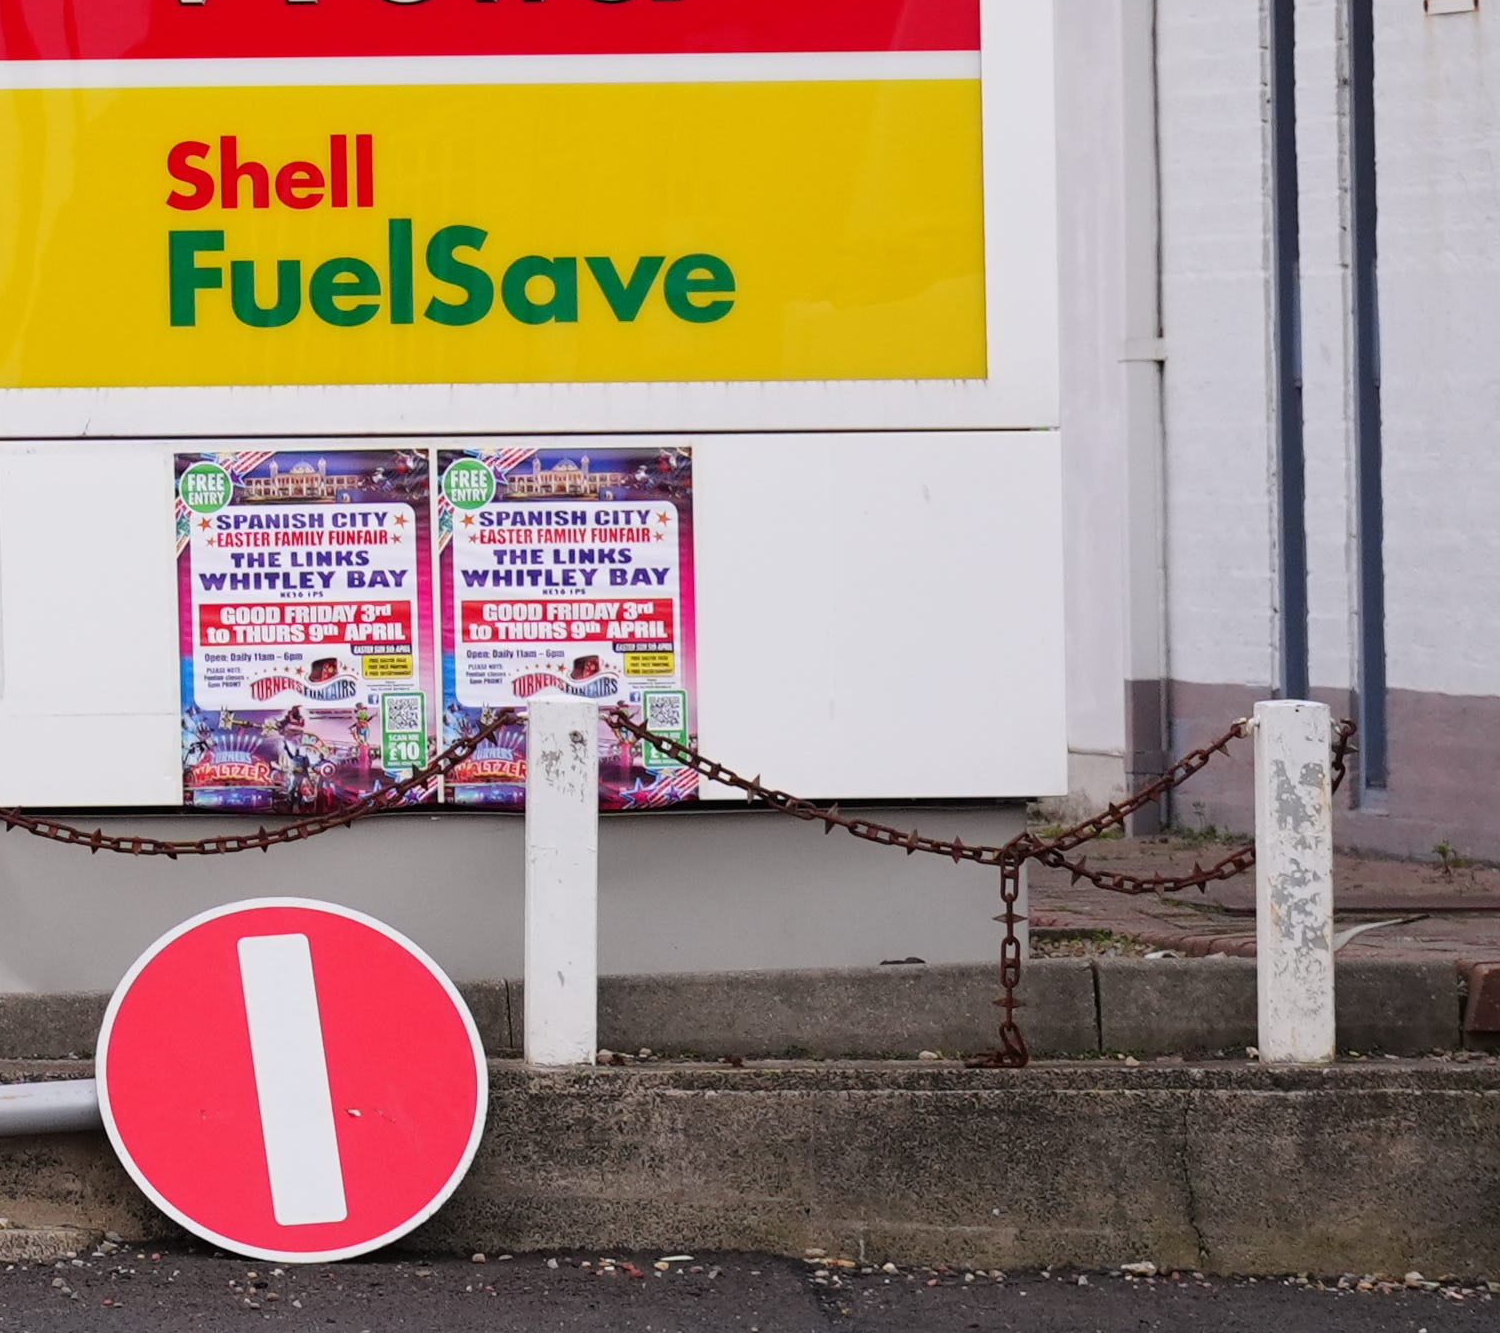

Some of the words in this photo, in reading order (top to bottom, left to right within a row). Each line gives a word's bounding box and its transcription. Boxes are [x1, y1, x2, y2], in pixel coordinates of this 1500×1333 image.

[165, 133, 375, 213] Shell
[167, 218, 736, 327] FuelSave
[188, 473, 224, 492] FREE
[450, 470, 488, 488] FREE
[188, 491, 225, 505] ENTRY
[451, 488, 488, 503] ENTRY
[216, 513, 325, 530] SPANISH
[332, 511, 388, 528] CITY
[479, 510, 587, 527] SPANISH
[594, 509, 651, 525] CITY
[217, 532, 270, 548] EASTER
[275, 531, 324, 547] FAMILY
[329, 530, 388, 545] FUNFAIR
[479, 529, 532, 545] EASTER
[537, 528, 586, 544] FAMILY
[591, 527, 650, 543] FUNFAIR
[231, 552, 281, 568] THE
[291, 550, 369, 567] LINKS
[493, 549, 544, 565] THE
[553, 548, 632, 564] LINKS
[199, 571, 336, 591] WHITLEY
[347, 570, 408, 589] BAY
[461, 569, 598, 587] WHITLEY
[609, 568, 671, 587] BAY
[220, 606, 281, 625] GOOD
[284, 605, 357, 624] FRIDAY
[361, 603, 392, 622] 3rd
[482, 603, 543, 622] GOOD
[546, 602, 620, 621] FRIDAY
[623, 602, 654, 620] 3rd
[207, 627, 230, 644] to
[233, 624, 305, 643] THURS
[309, 624, 338, 642] 9th
[344, 623, 406, 641] APRIL
[469, 623, 492, 641] to
[495, 622, 567, 640] THURS
[571, 621, 600, 639] 9th
[606, 621, 667, 638] APRIL
[230, 653, 252, 662] Daily
[254, 652, 275, 661] 11am
[283, 652, 303, 661] 6pm
[492, 649, 514, 658] Daily
[516, 649, 537, 658] 11am
[546, 648, 564, 658] 6pm
[249, 675, 302, 702] TURNERS
[303, 679, 357, 701] FUNFAIRS
[512, 673, 565, 698] TURNERS
[565, 676, 619, 697] FUNFAIRS
[389, 741, 420, 761] £10
[193, 763, 272, 783] WALTZER
